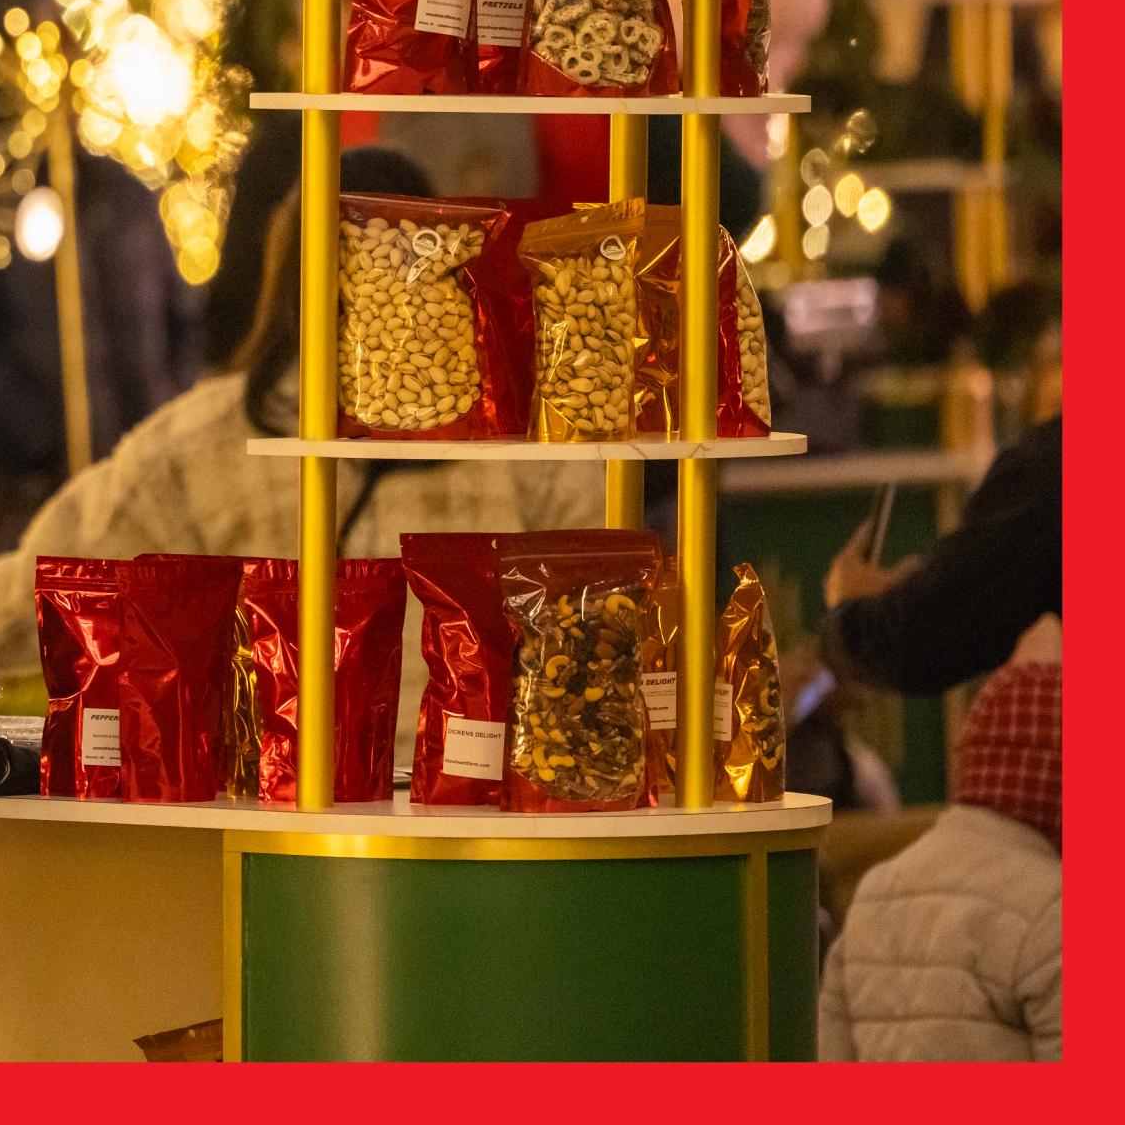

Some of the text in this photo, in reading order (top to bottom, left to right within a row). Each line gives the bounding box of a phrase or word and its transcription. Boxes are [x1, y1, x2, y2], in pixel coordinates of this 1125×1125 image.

[483, 0, 522, 9] PRETZELS
[646, 677, 676, 685] DELIGHT
[448, 728, 474, 736] DICKENS
